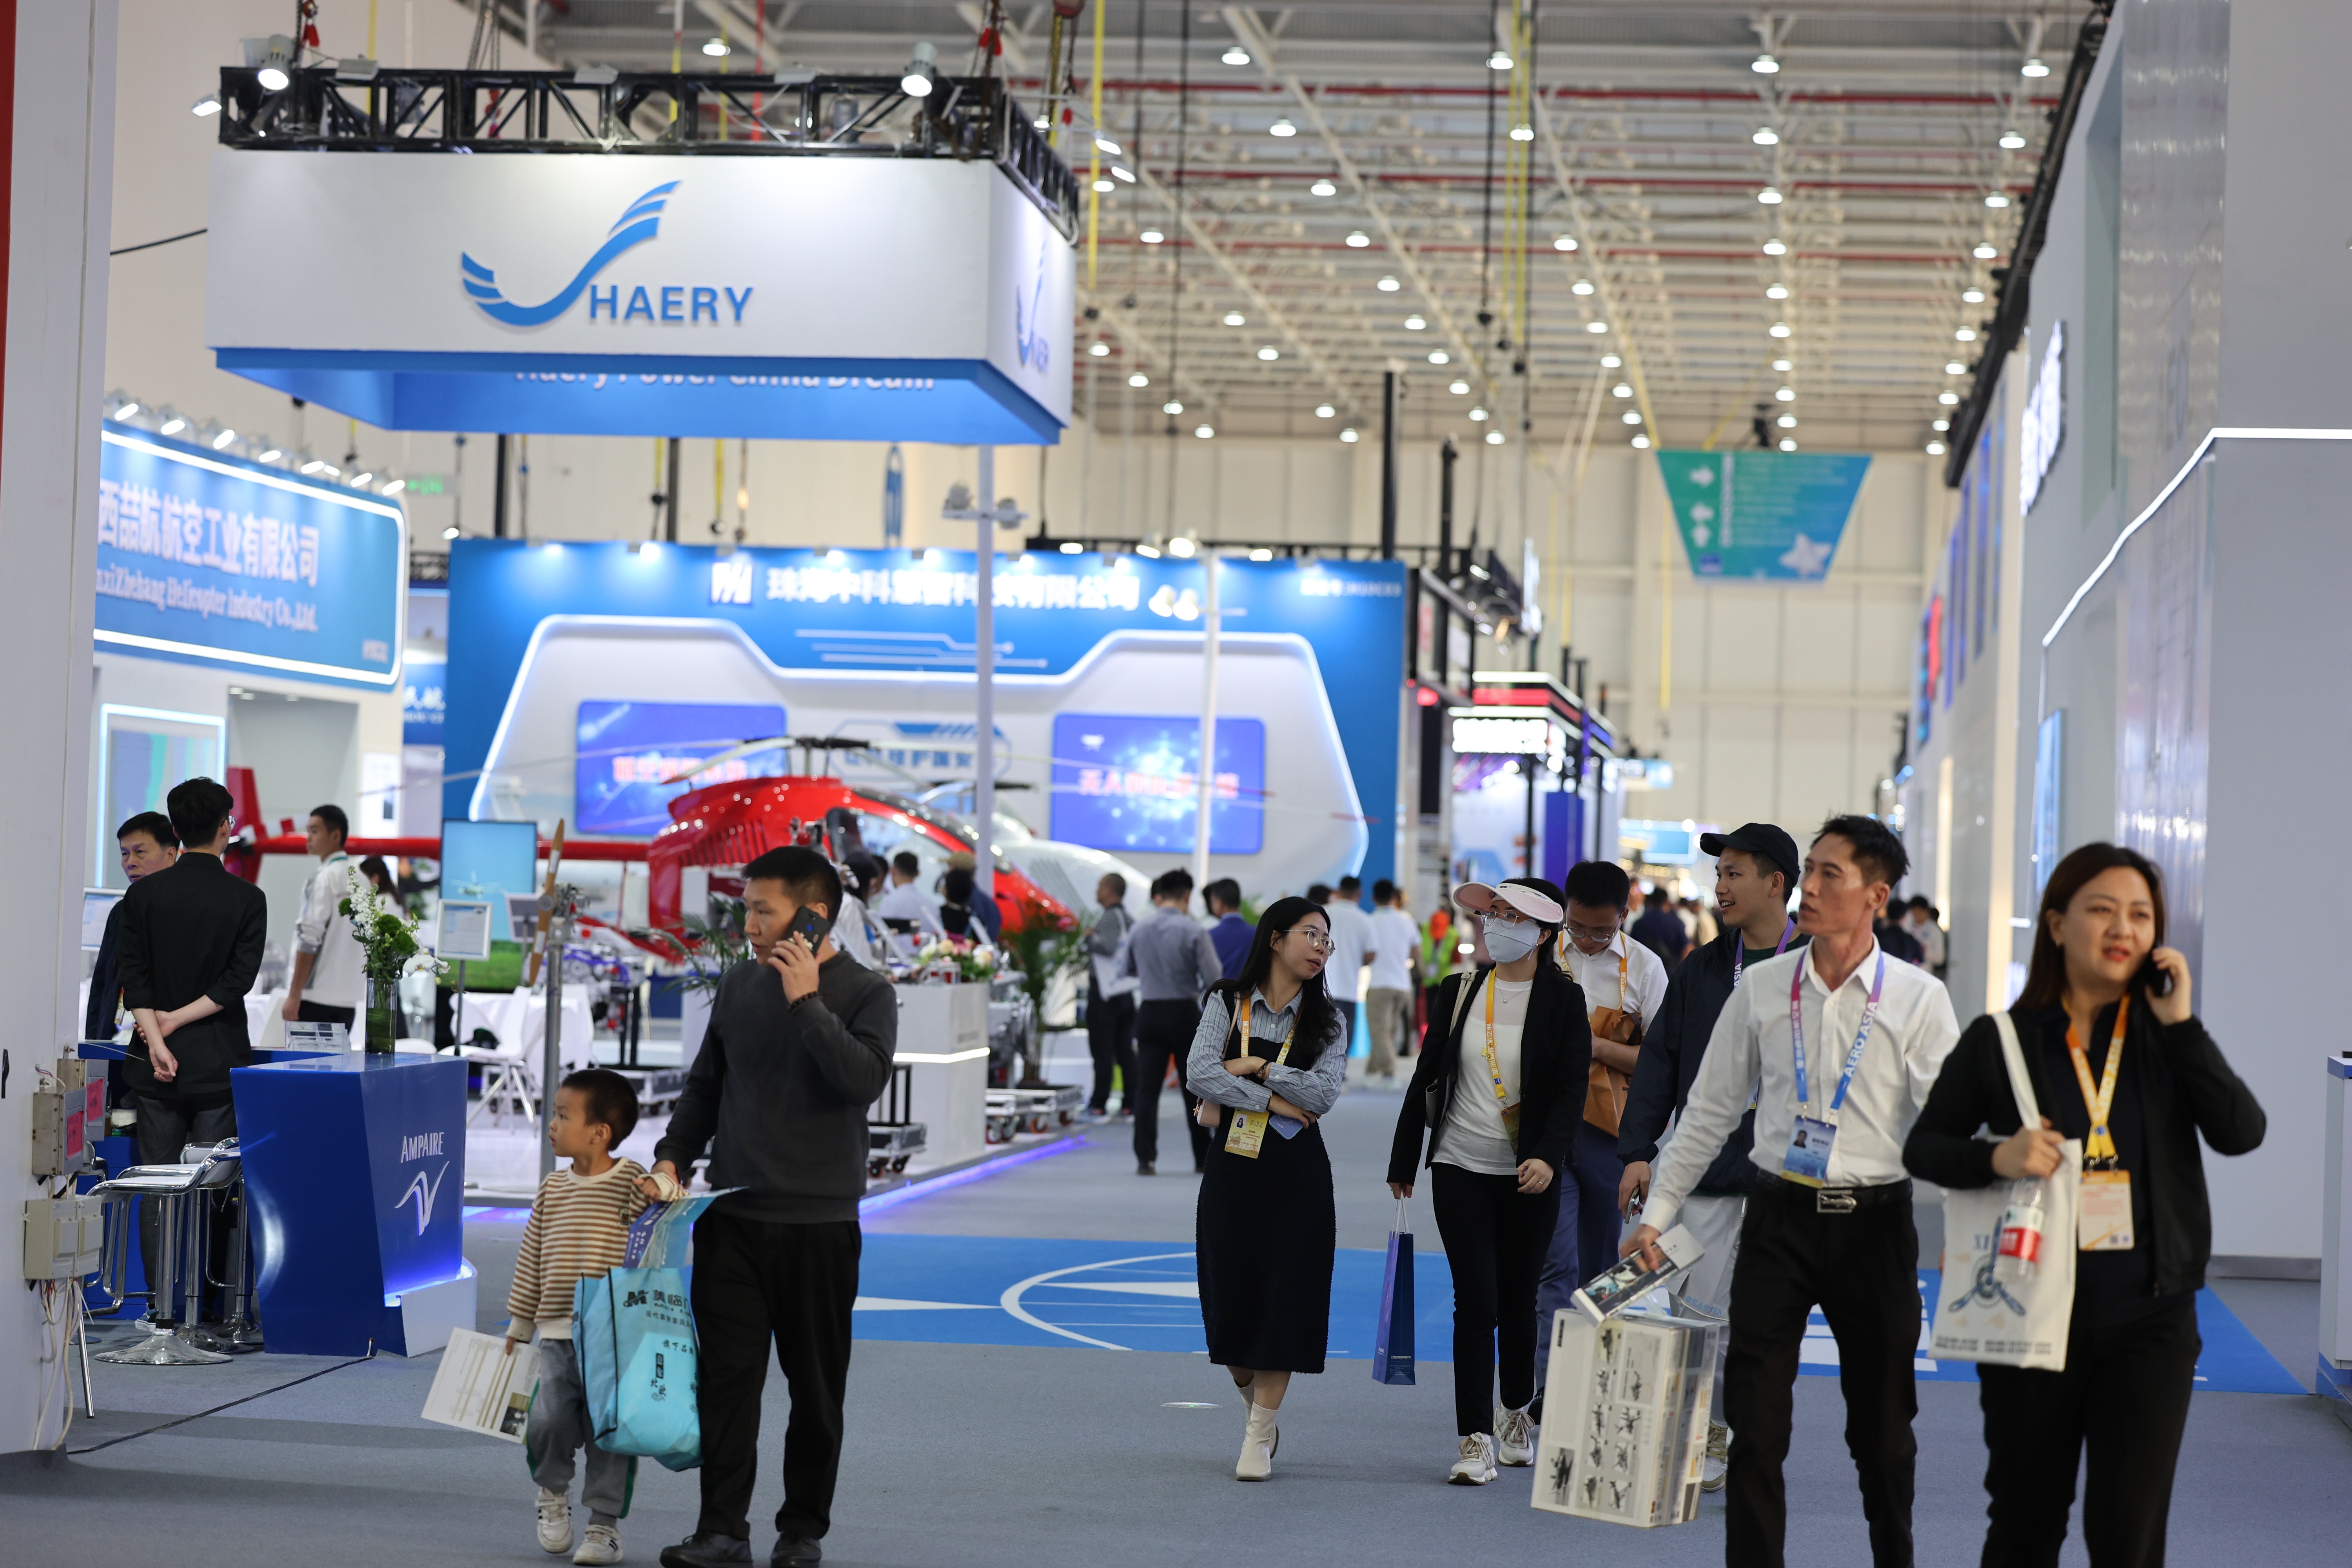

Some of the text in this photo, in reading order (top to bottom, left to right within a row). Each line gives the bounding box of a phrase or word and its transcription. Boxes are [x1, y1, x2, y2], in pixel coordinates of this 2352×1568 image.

[590, 285, 753, 323] HAERY
[1733, 962, 1742, 986] ASIA
[1844, 1002, 1878, 1078] AERO ASIA
[401, 1132, 445, 1163] AMPAIRE
[1686, 1295, 1722, 1316] BEASTER
